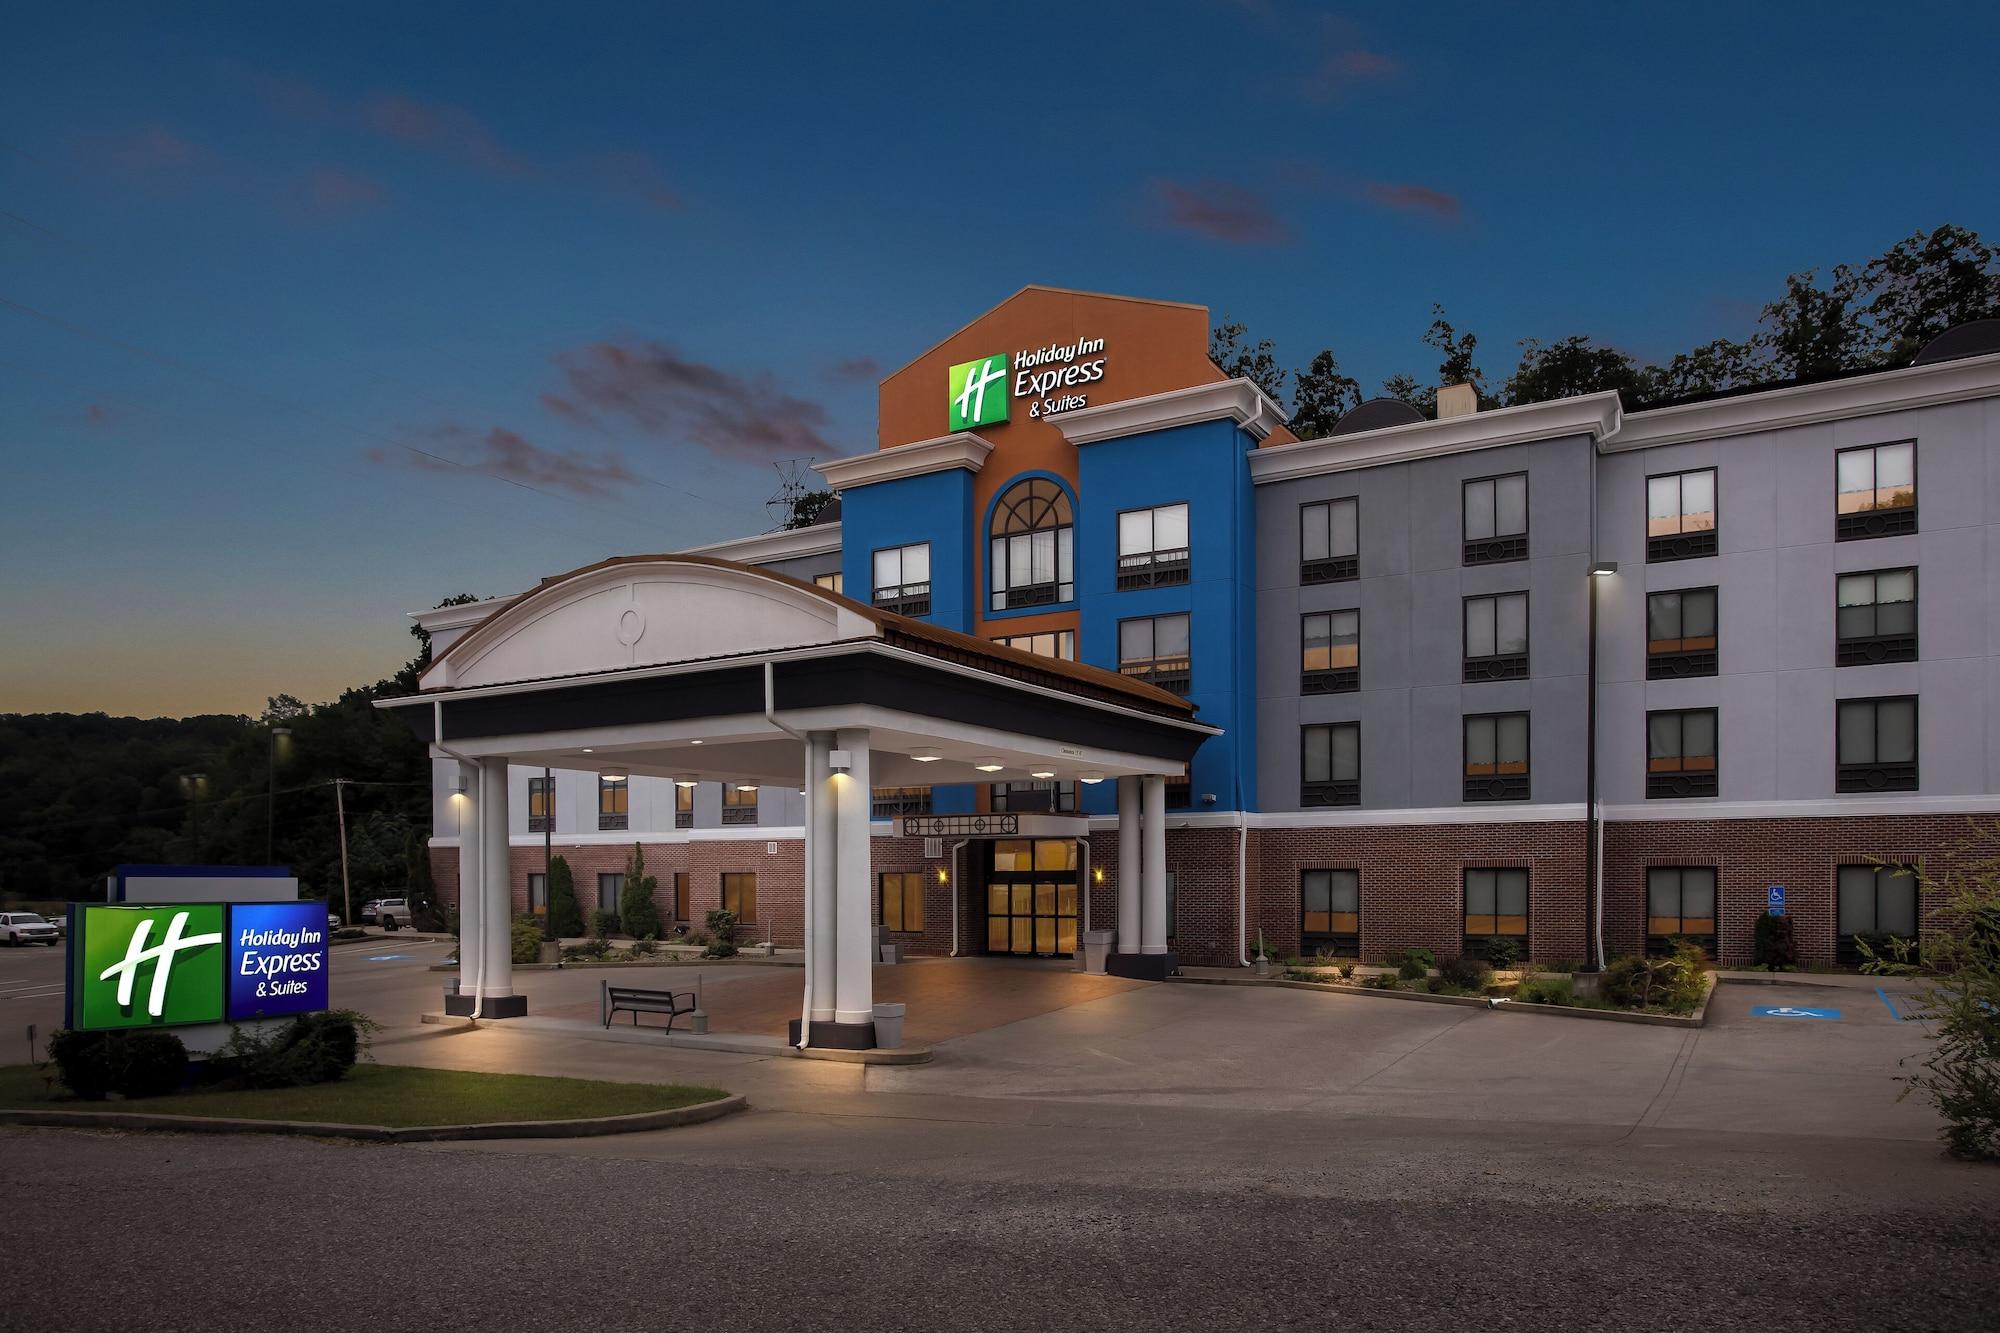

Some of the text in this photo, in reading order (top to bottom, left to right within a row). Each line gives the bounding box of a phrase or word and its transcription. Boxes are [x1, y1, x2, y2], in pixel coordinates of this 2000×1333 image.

[1014, 336, 1104, 370] Holiday Inn
[1014, 360, 1105, 398] Express
[1029, 394, 1087, 418] & Suites
[239, 927, 321, 949] Holiday Inn
[240, 951, 321, 980] Express
[256, 980, 308, 997] & Suites
